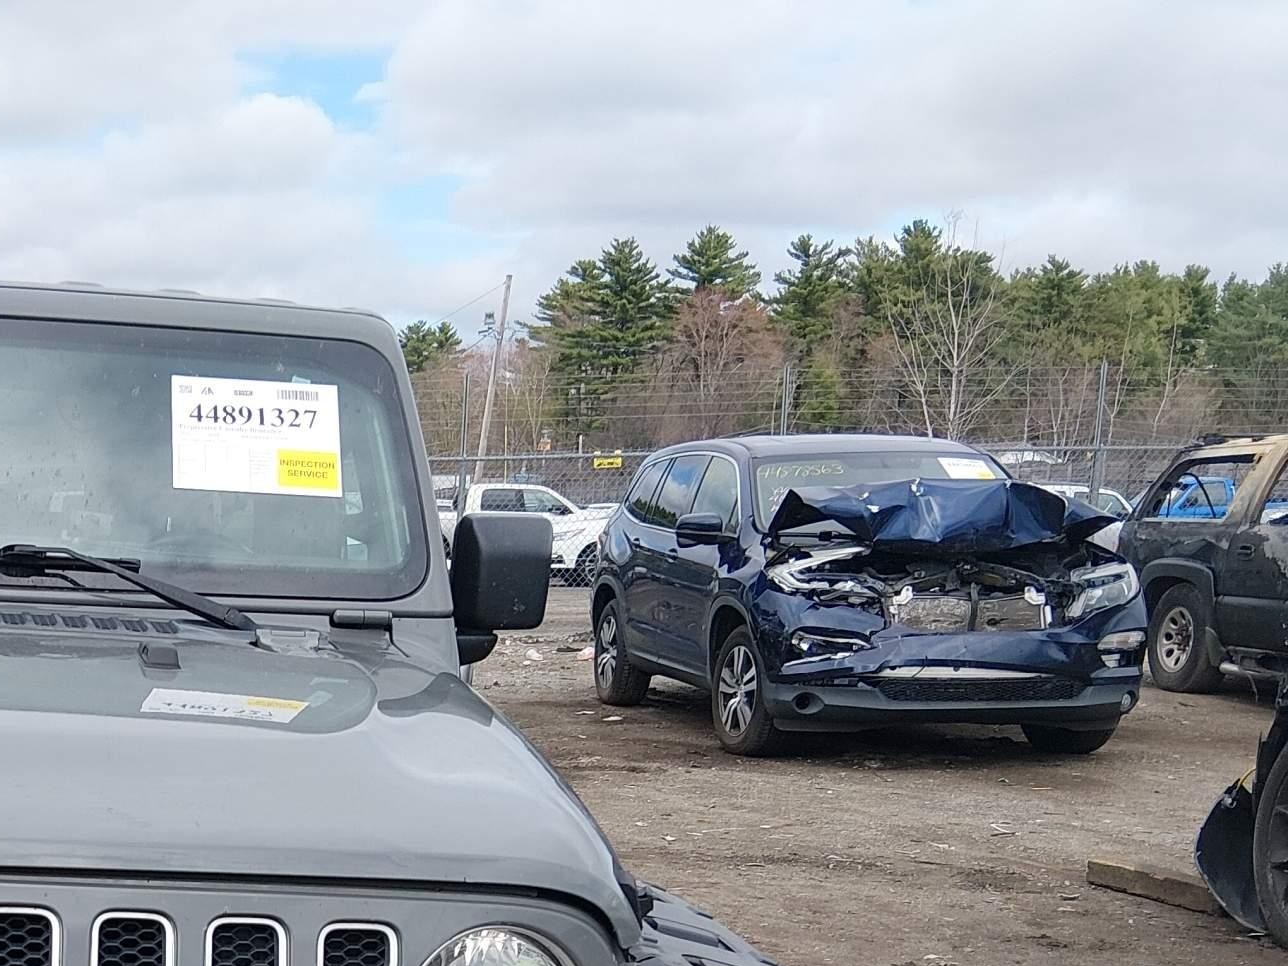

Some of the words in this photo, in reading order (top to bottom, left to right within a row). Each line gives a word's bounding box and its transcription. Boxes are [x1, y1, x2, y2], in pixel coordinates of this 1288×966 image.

[189, 403, 318, 429] 44891327
[279, 458, 335, 470] INSPECTION
[287, 468, 329, 479] SERVICE
